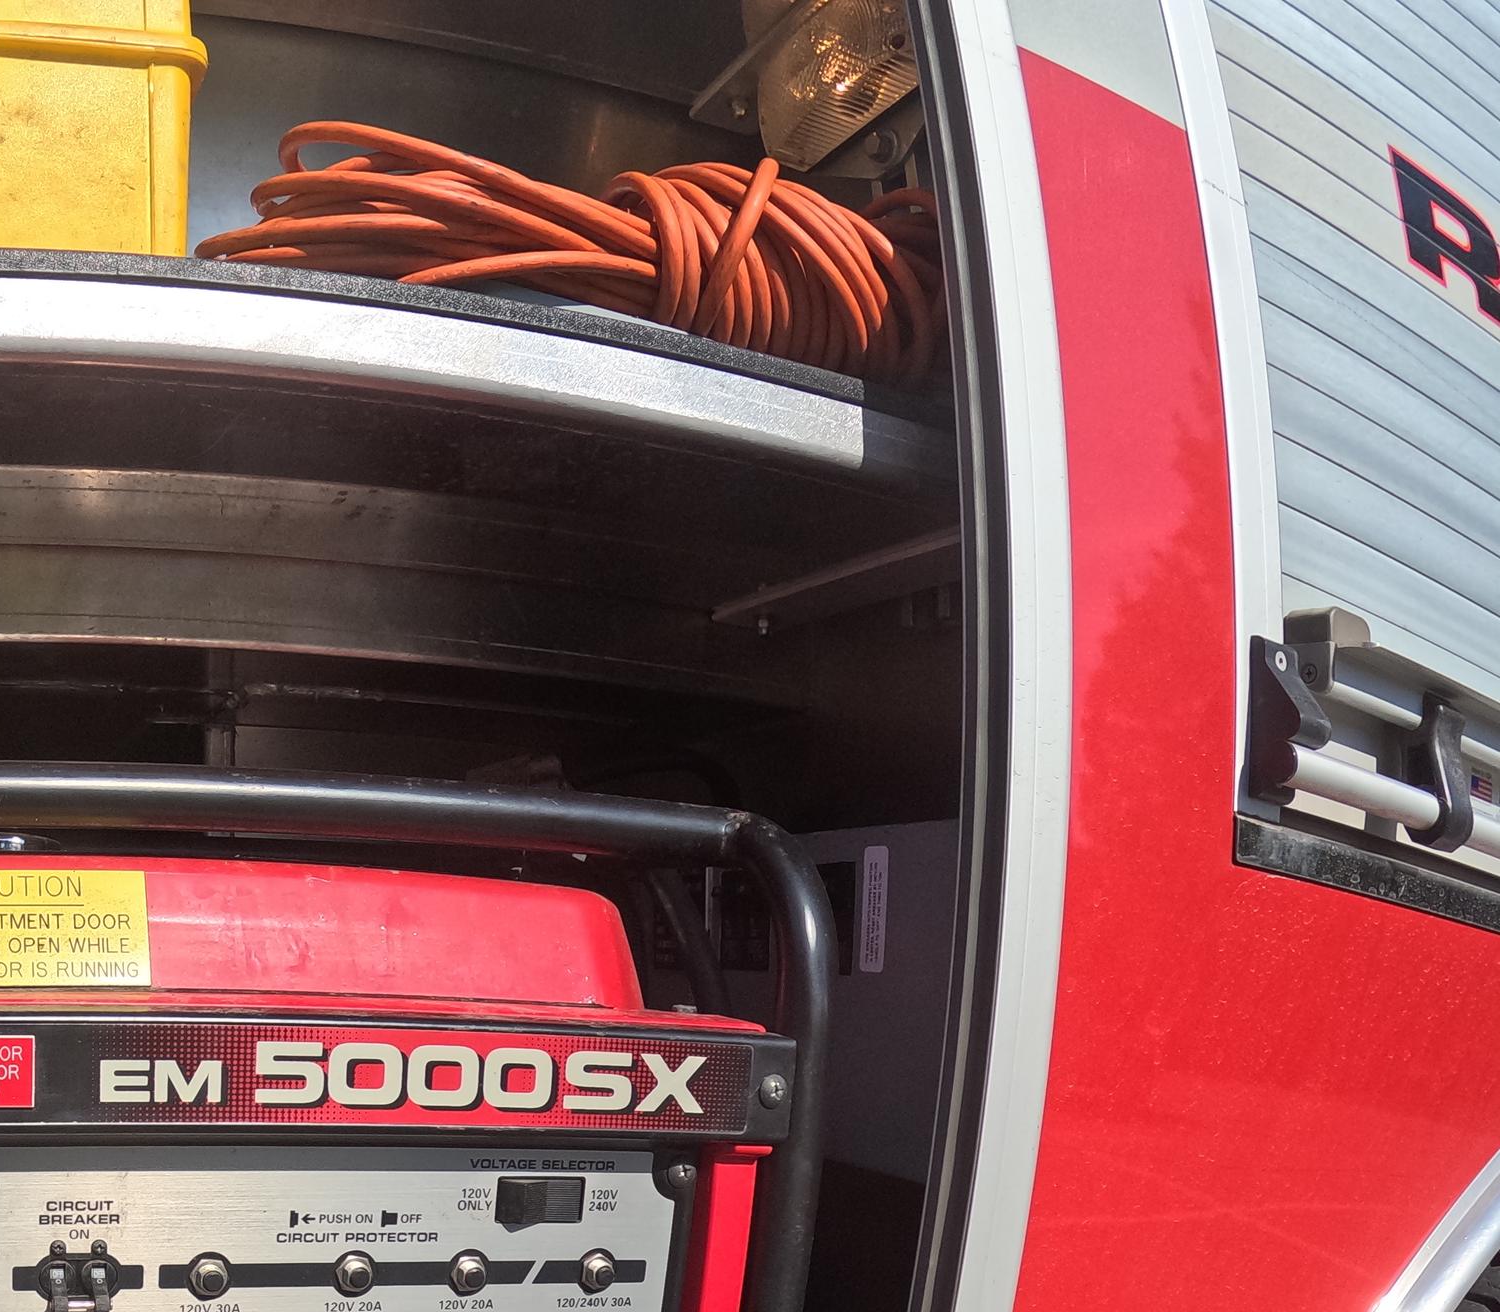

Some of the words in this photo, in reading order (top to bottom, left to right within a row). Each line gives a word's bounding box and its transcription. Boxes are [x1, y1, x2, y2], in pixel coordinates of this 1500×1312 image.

[1387, 143, 1500, 327] R
[73, 913, 131, 930] DOOR
[8, 937, 60, 954] OPEN
[68, 937, 130, 954] WHILE
[32, 961, 48, 978] IS
[56, 961, 139, 978] RUNNING
[0, 1046, 23, 1061] OR
[100, 1059, 223, 1104] EM
[255, 1040, 709, 1115] 5000SX
[470, 1158, 539, 1171] VOLTAGE
[541, 1159, 616, 1171] SELECTOR
[461, 1188, 491, 1199] 120V
[591, 1189, 619, 1200] 120V
[46, 1200, 114, 1212] CIRCUIT
[457, 1200, 492, 1212] ONLY
[588, 1201, 618, 1212] 240V
[38, 1214, 120, 1225] BREAKER
[319, 1213, 352, 1224] PUSH
[355, 1213, 373, 1224] ON
[400, 1213, 422, 1224] OFF
[69, 1229, 90, 1240] ON
[276, 1233, 340, 1243] CIRCUIT
[345, 1232, 438, 1243] PROTECTOR
[324, 1301, 355, 1312] 120V
[359, 1301, 382, 1312] 20A
[438, 1300, 468, 1310] 120V
[471, 1299, 493, 1310] 20A
[556, 1298, 609, 1308] 120/240V
[610, 1297, 632, 1307] 30A
